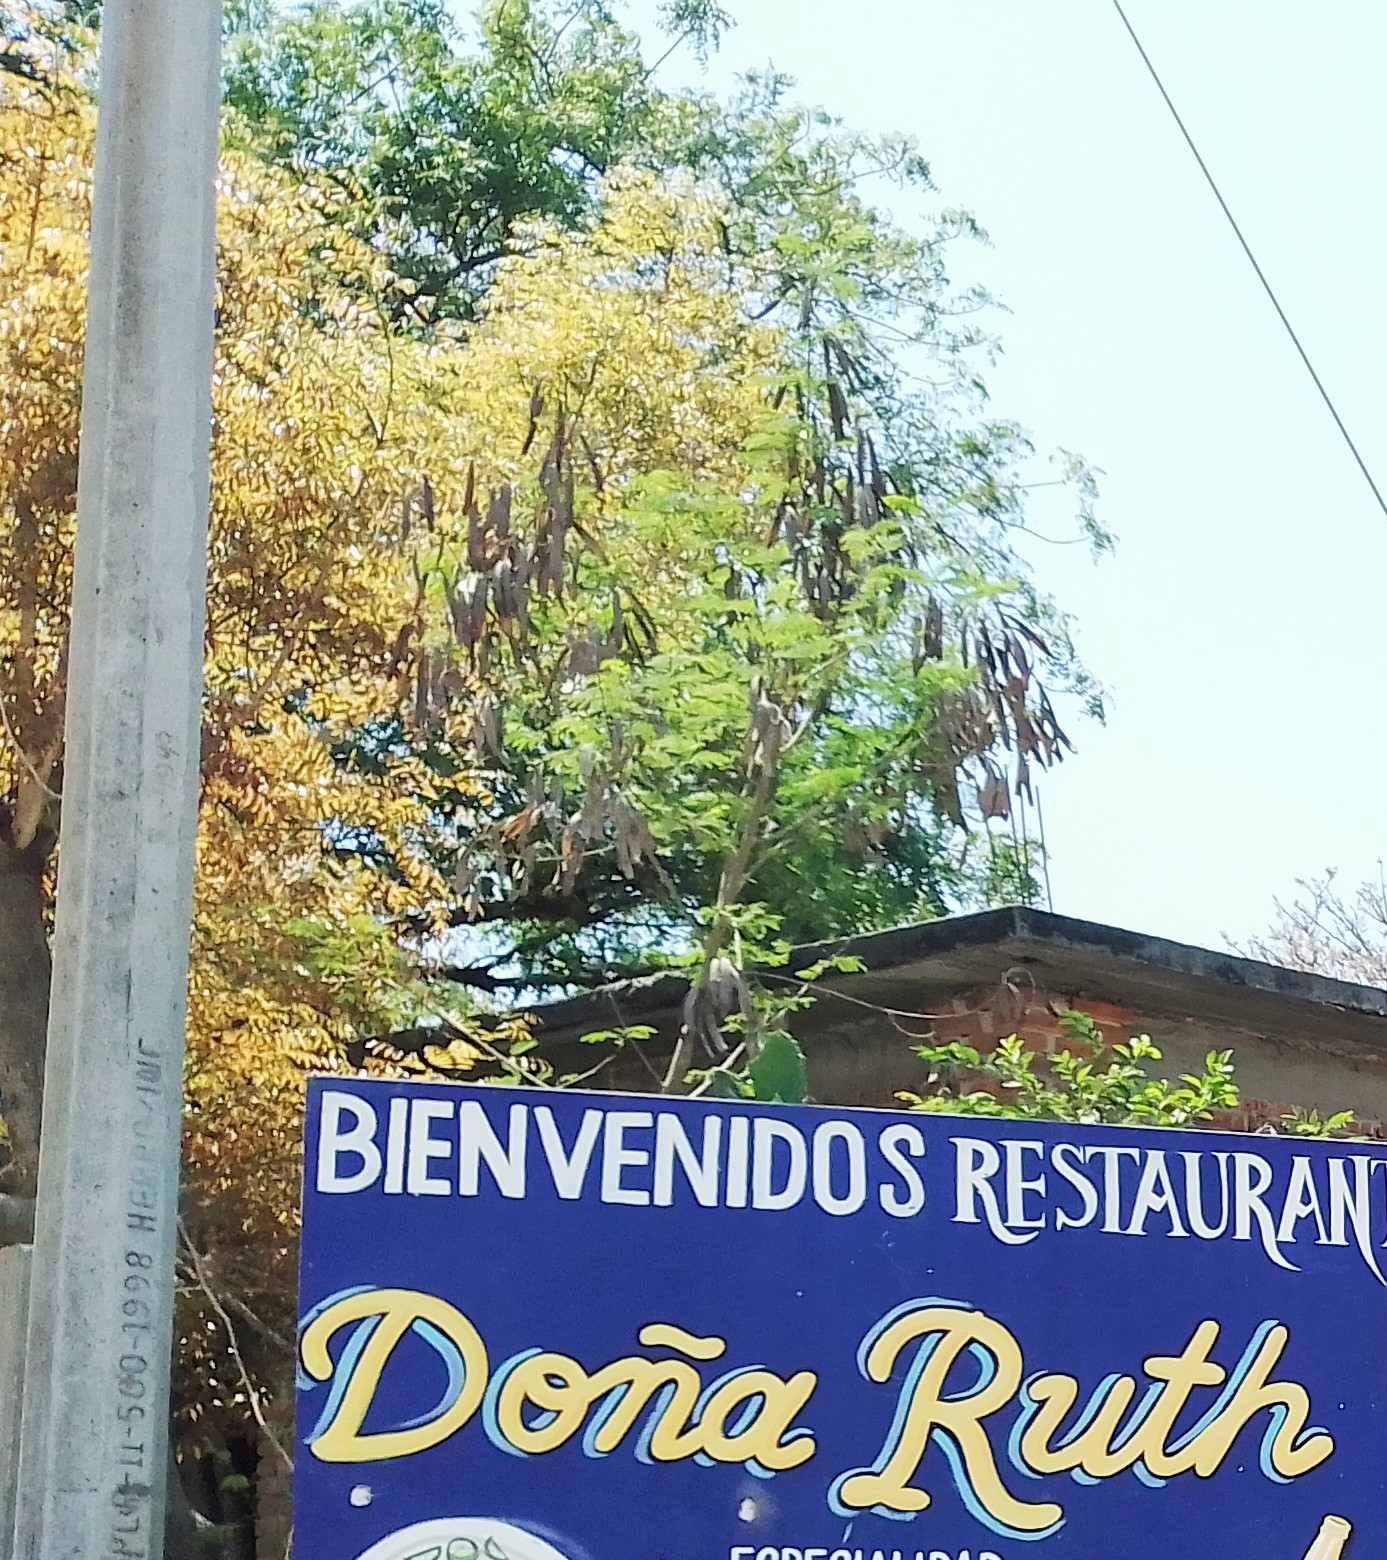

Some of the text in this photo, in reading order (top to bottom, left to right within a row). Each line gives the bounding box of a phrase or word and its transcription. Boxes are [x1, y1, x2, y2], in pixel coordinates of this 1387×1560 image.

[316, 1091, 926, 1217] BIENVENIDOS
[298, 1285, 1335, 1540] Doña Ruth
